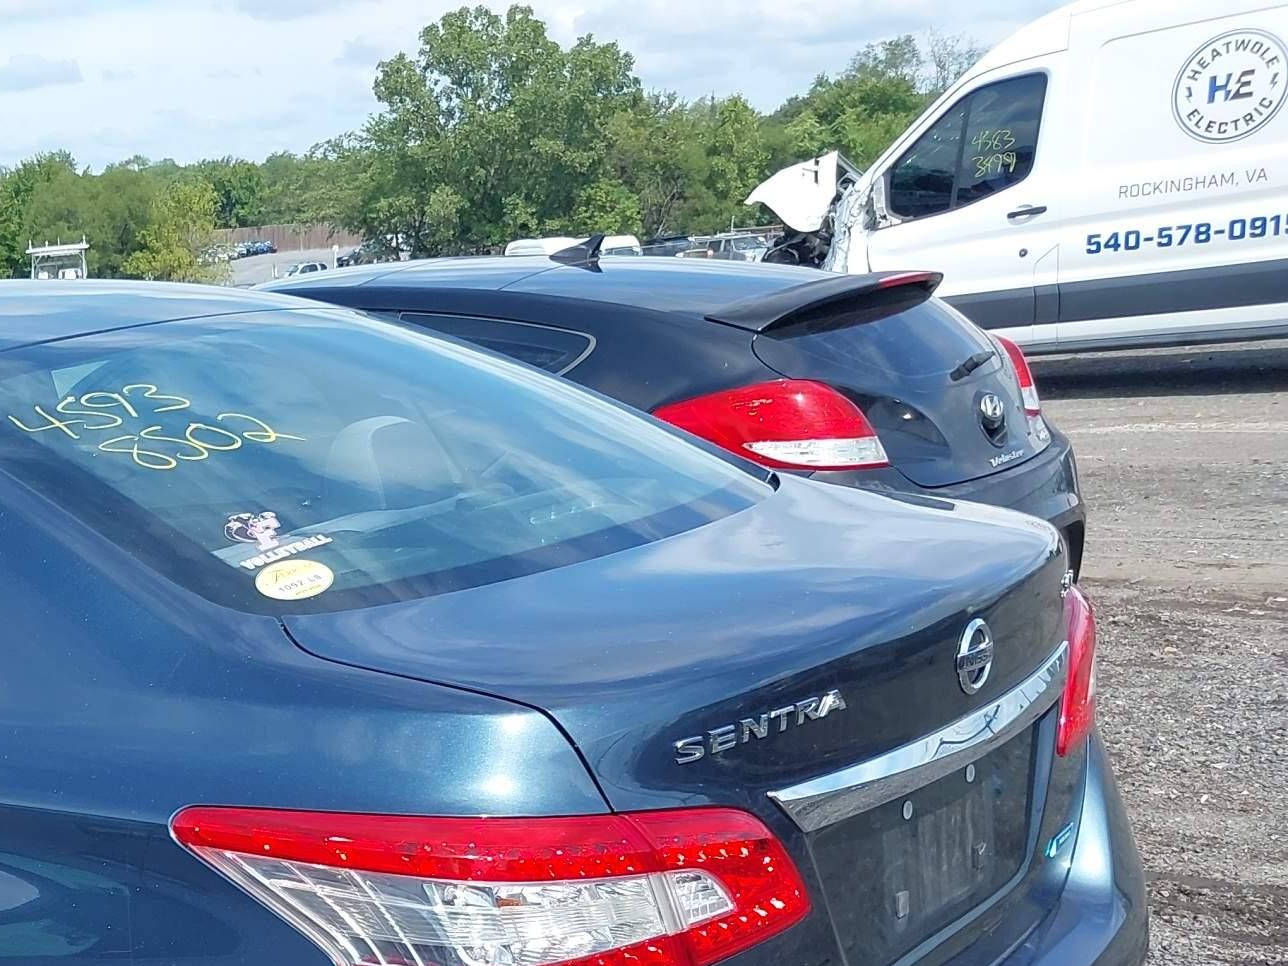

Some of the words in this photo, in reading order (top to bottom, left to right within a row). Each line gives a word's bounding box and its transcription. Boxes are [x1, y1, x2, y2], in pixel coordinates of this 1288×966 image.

[1186, 38, 1280, 82] HEATWOLE
[1207, 68, 1256, 105] HE
[1185, 96, 1273, 134] ELECTRIC
[1118, 172, 1239, 198] ROCKINGHAM,
[1245, 167, 1268, 183] VA
[8, 383, 191, 439] 4593
[98, 412, 306, 470] 8502
[239, 534, 334, 570] VOLLEYBALL
[673, 689, 847, 765] SENTRA
